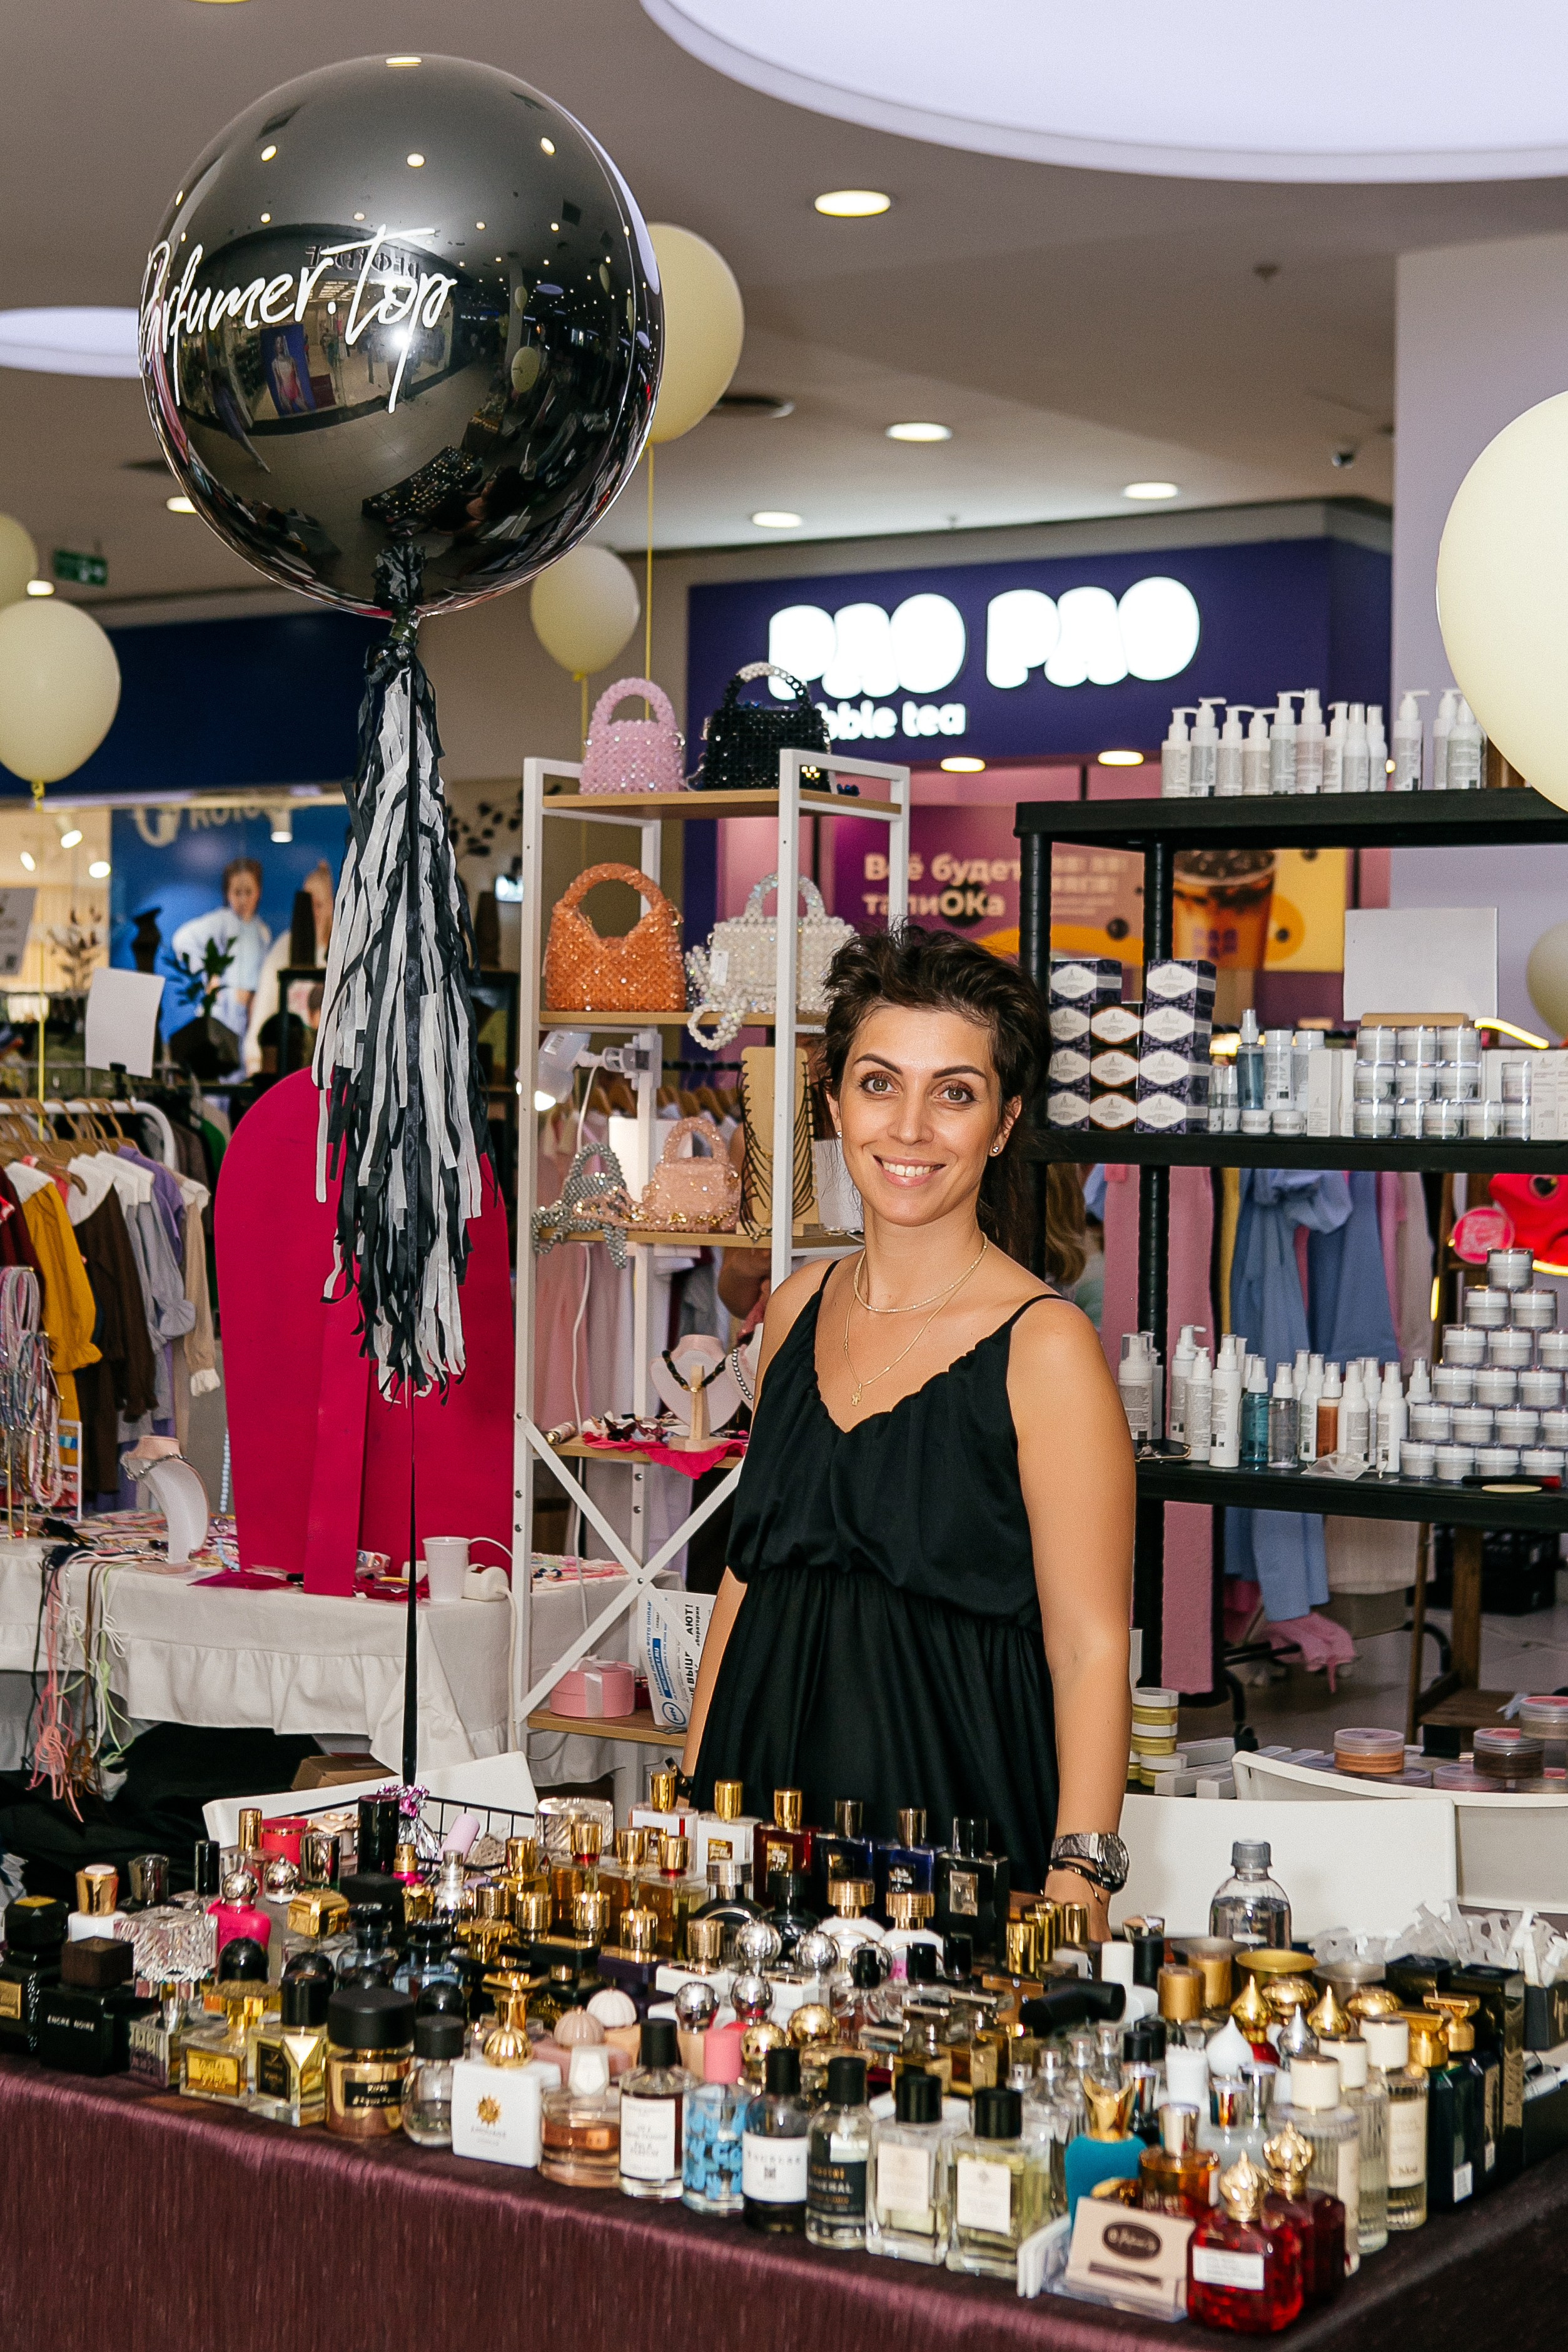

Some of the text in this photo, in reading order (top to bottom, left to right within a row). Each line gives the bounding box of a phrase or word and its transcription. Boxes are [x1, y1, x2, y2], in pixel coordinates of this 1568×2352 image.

[768, 576, 1200, 701] PAO PAO
[815, 699, 966, 741] bble tea
[864, 853, 924, 882] Вё
